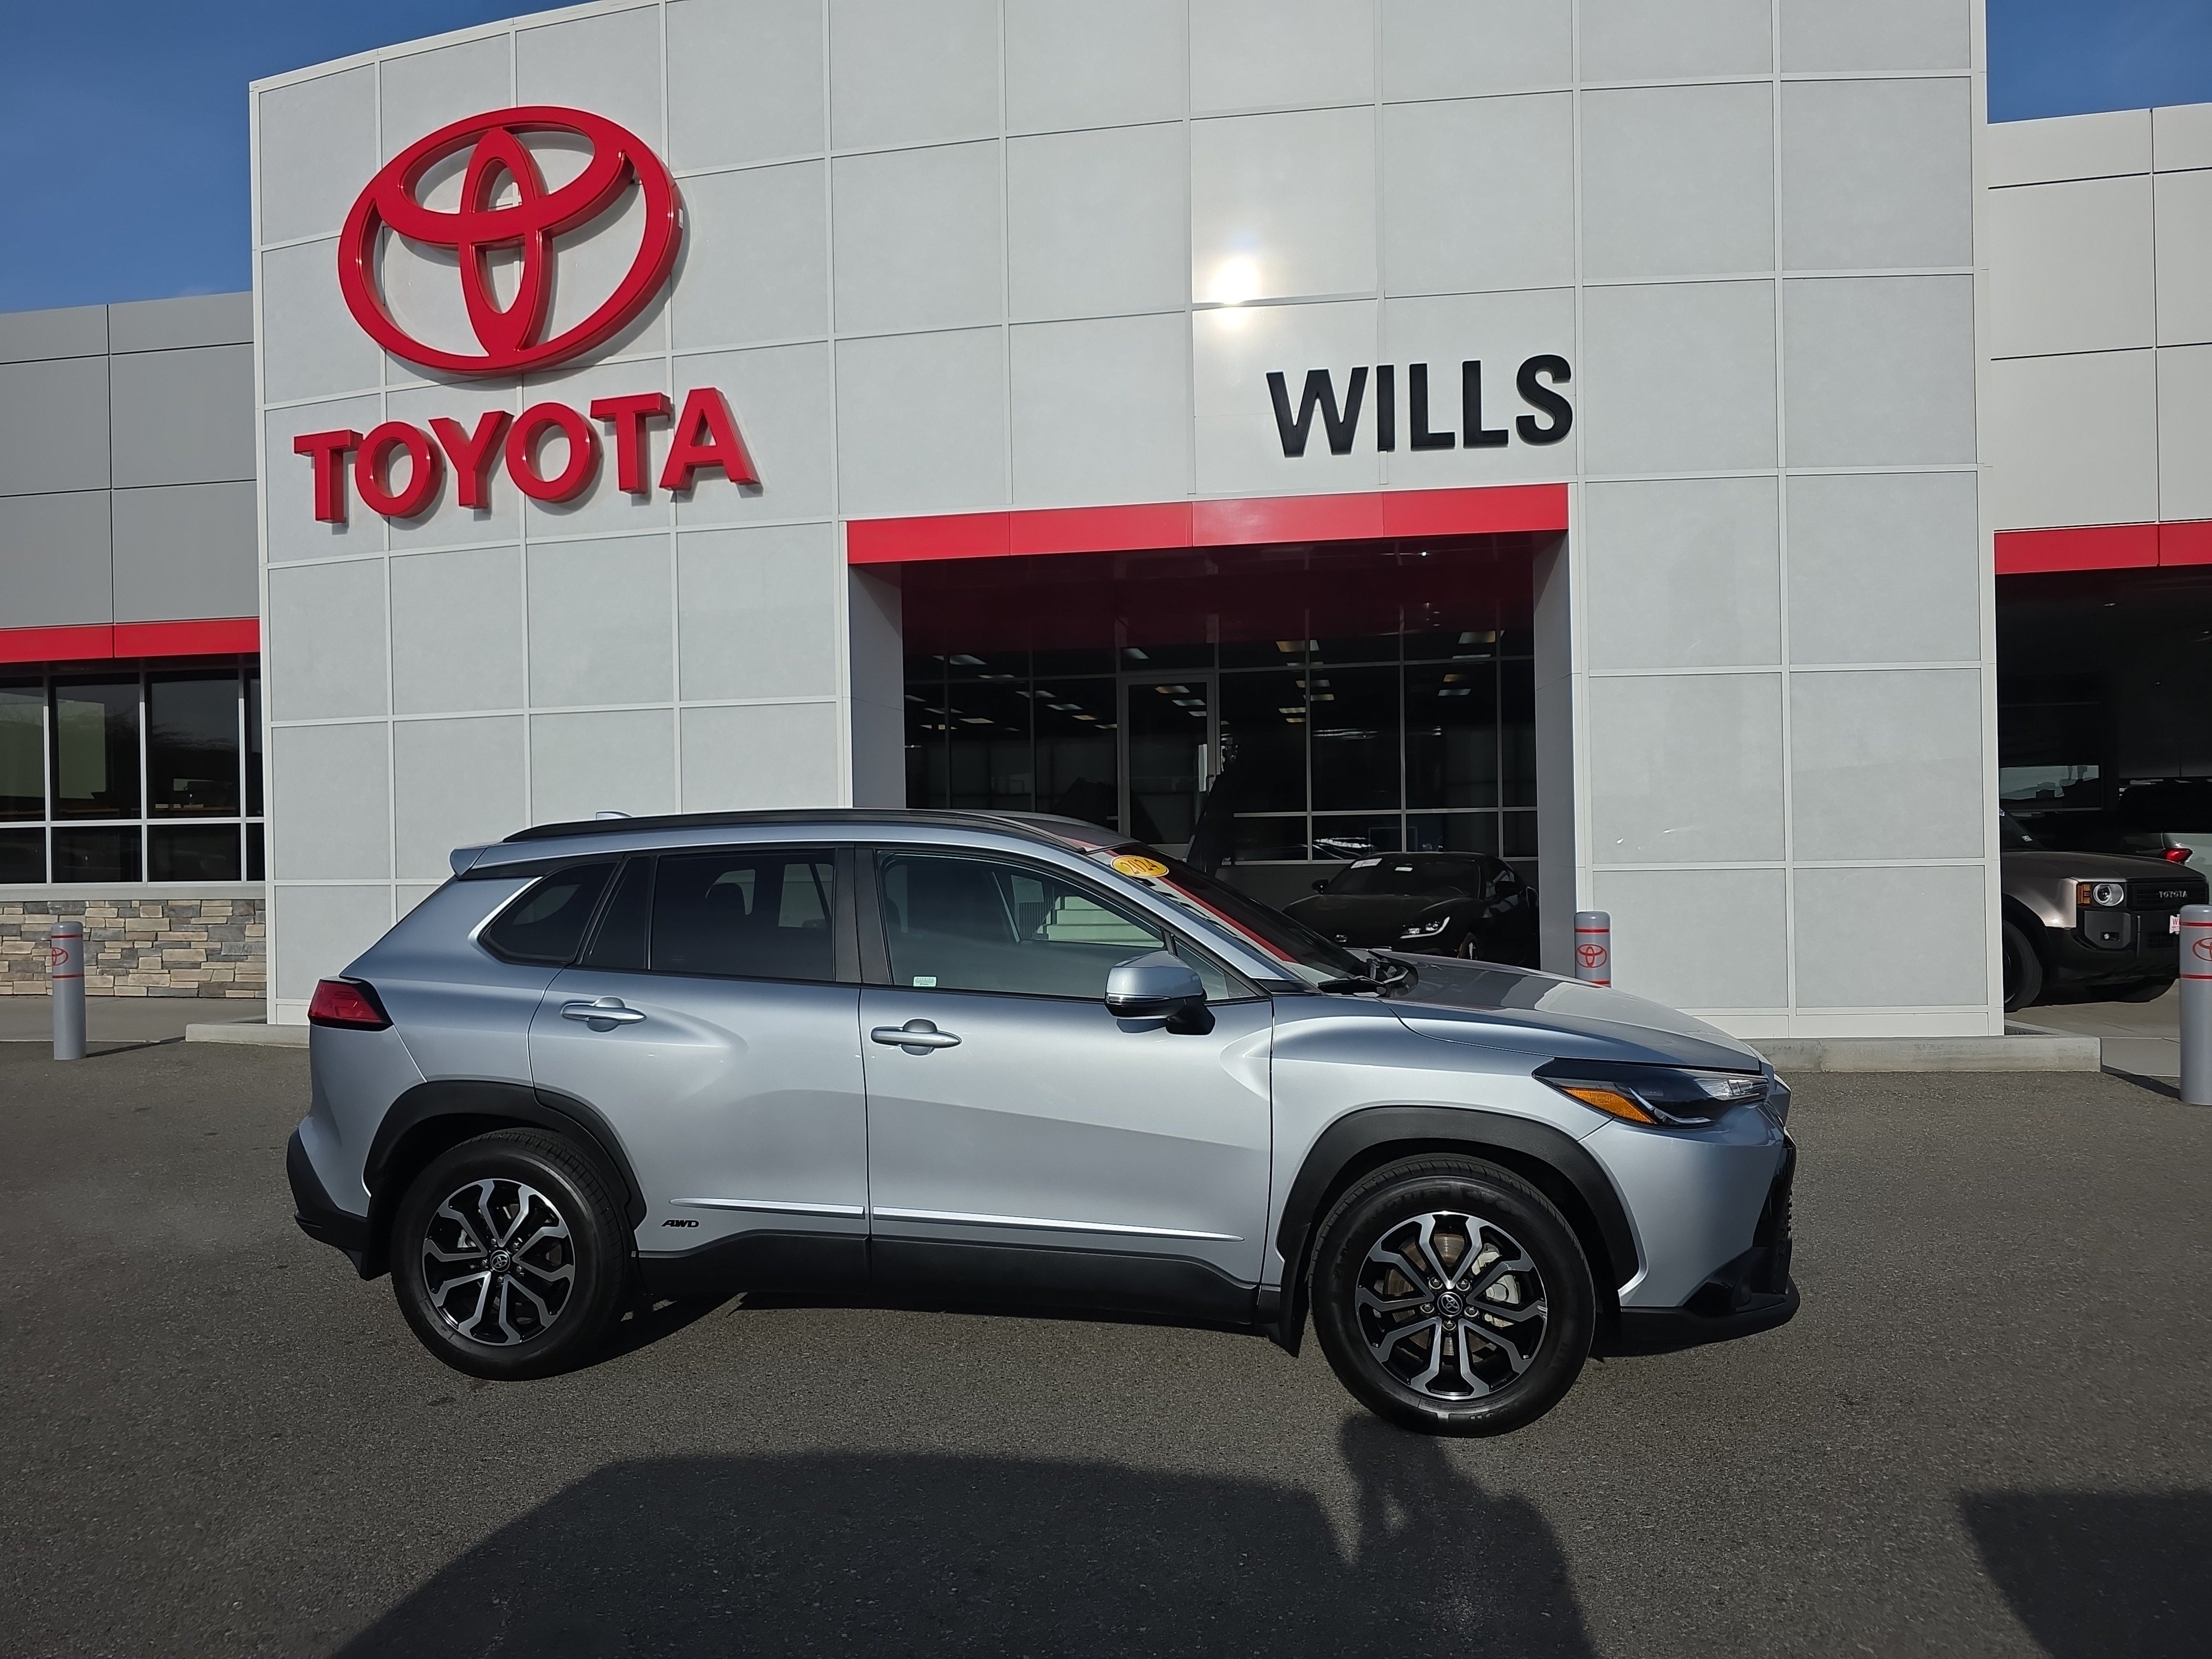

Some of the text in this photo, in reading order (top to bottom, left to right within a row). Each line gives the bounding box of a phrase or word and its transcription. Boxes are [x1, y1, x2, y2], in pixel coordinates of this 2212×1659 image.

[1266, 354, 1573, 458] WILLS
[293, 387, 760, 523] TOYOTA
[1121, 858, 1160, 874] 2024
[661, 1219, 699, 1227] AWD
